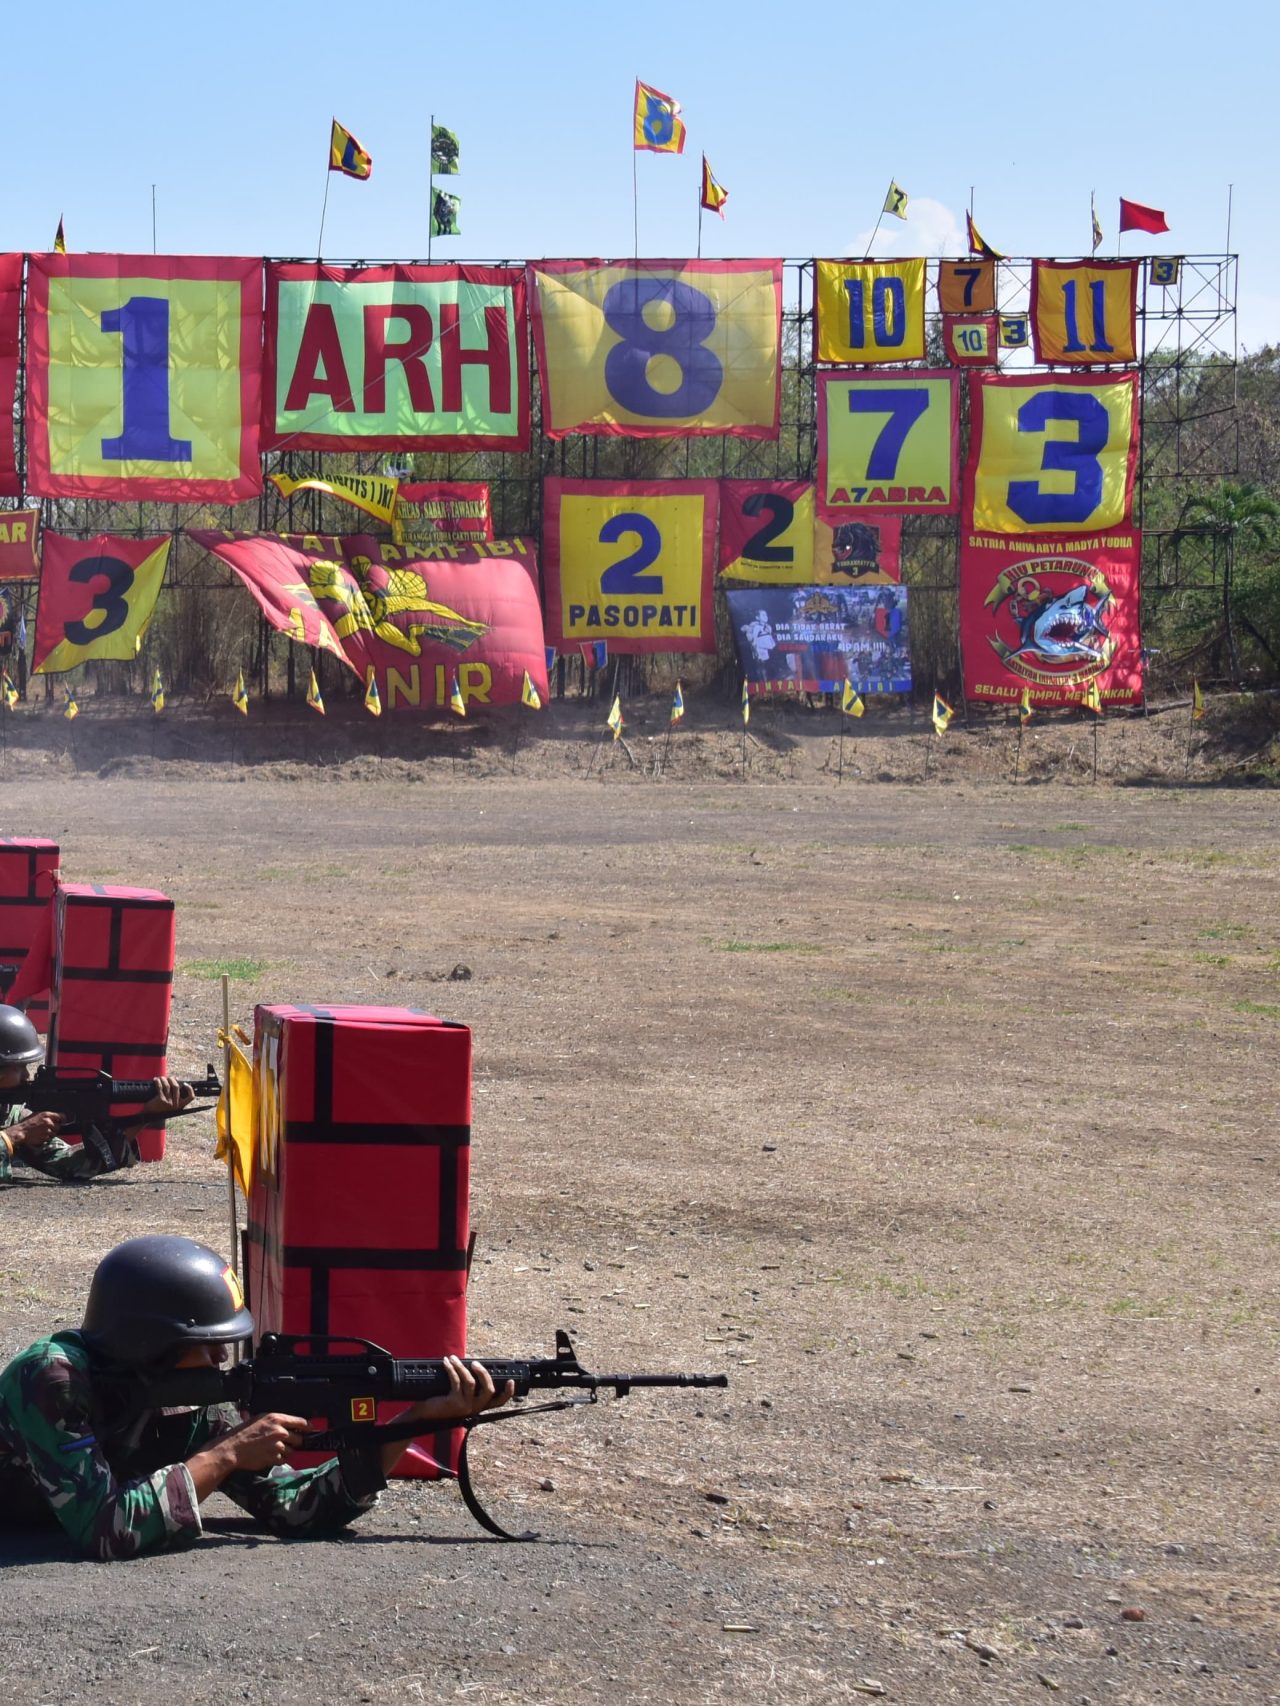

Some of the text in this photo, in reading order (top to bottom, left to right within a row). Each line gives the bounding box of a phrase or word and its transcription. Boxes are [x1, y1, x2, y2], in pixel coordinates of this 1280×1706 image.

[1157, 262, 1173, 281] 3
[953, 268, 982, 307] 7
[843, 276, 906, 349] 10
[1061, 279, 1114, 353] 11
[958, 329, 983, 352] 10
[1003, 320, 1026, 344] 3
[284, 303, 511, 414] ARH
[603, 278, 723, 418] 8
[100, 296, 192, 462] 1
[849, 388, 929, 481] 7
[1006, 391, 1109, 524] 3
[830, 486, 947, 504] A7ABRA
[742, 493, 794, 562] 2
[379, 537, 528, 562] AMFIBI
[599, 512, 663, 595] 2
[969, 536, 1006, 549] SATRIA
[1065, 539, 1099, 552] MADYA
[1004, 565, 1028, 580] HIU
[64, 556, 135, 646] 3
[569, 604, 696, 627] PASOPATI
[775, 623, 790, 631] DIA
[777, 633, 791, 641] DIA
[974, 684, 1018, 698] SELALU
[359, 1403, 368, 1416] 2
